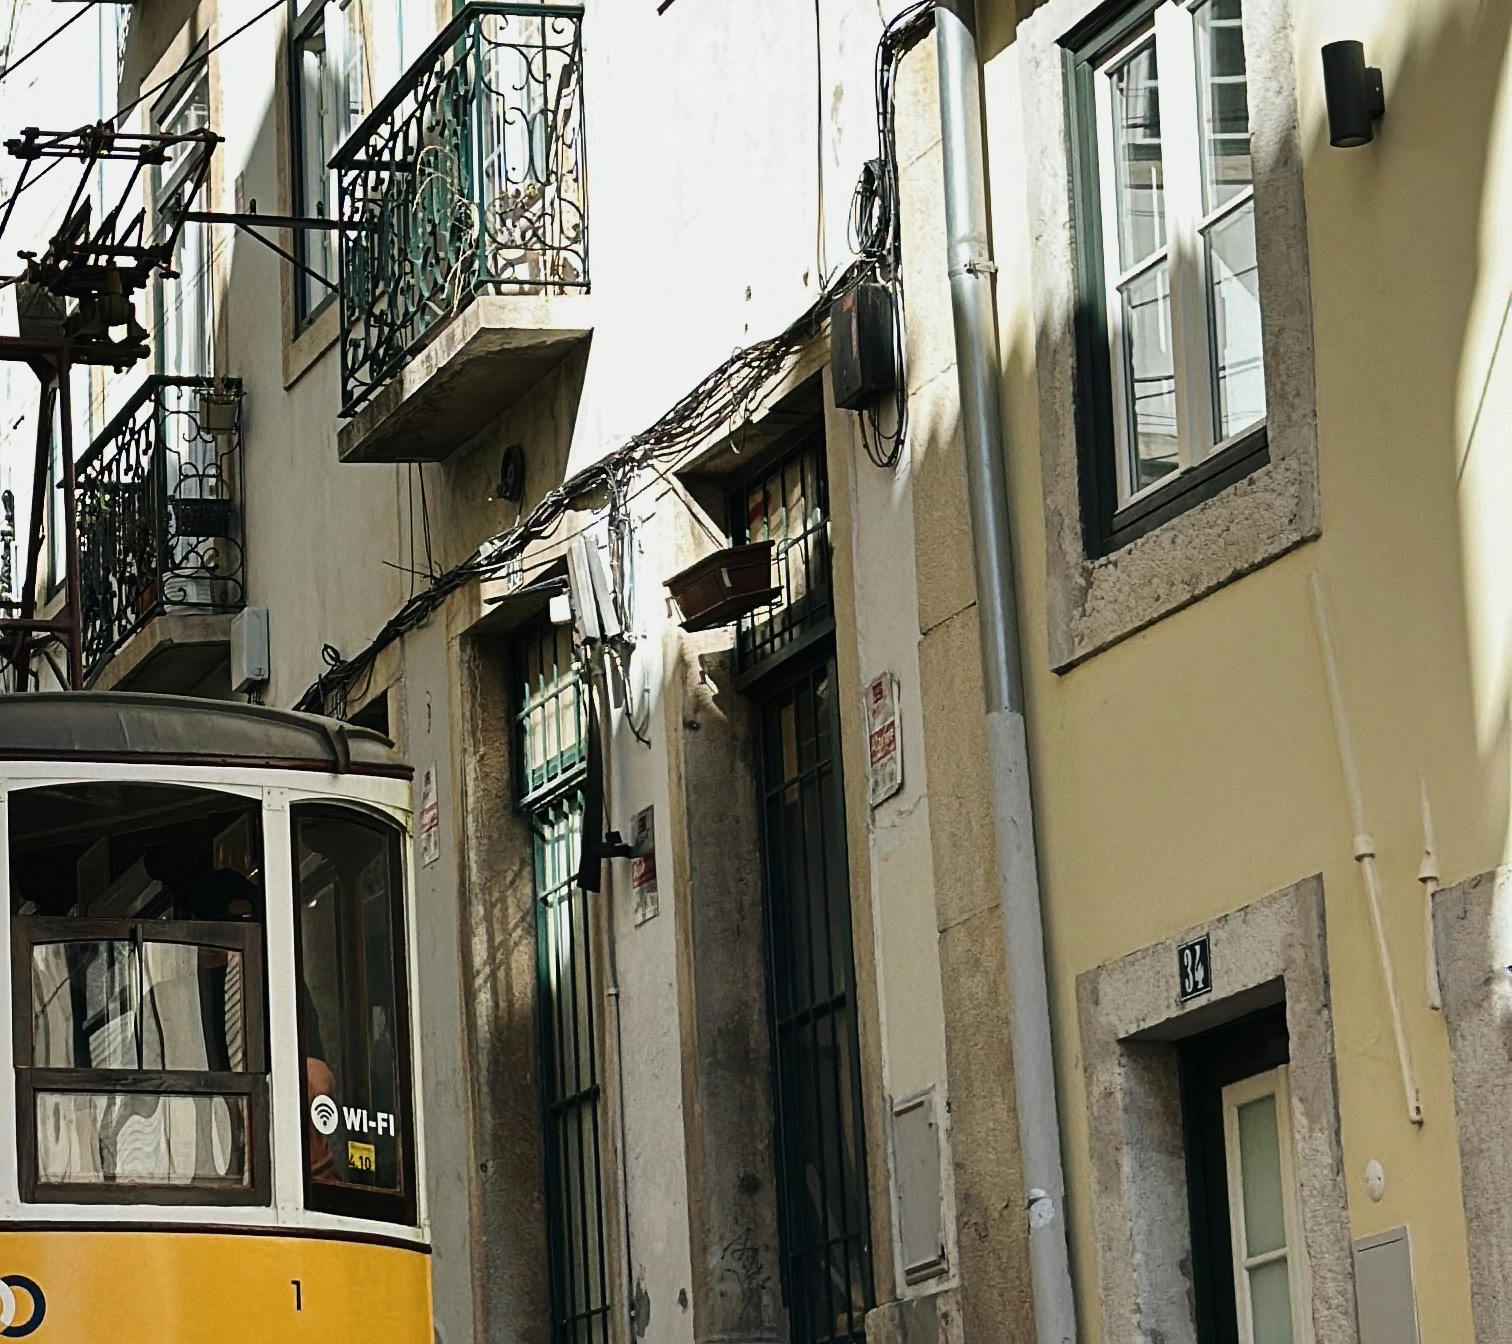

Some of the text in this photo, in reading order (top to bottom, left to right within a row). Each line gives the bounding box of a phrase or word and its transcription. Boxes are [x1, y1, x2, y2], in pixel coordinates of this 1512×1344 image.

[1183, 944, 1205, 993] 34
[342, 1106, 395, 1137] WI-FI
[290, 1279, 302, 1312] 1
